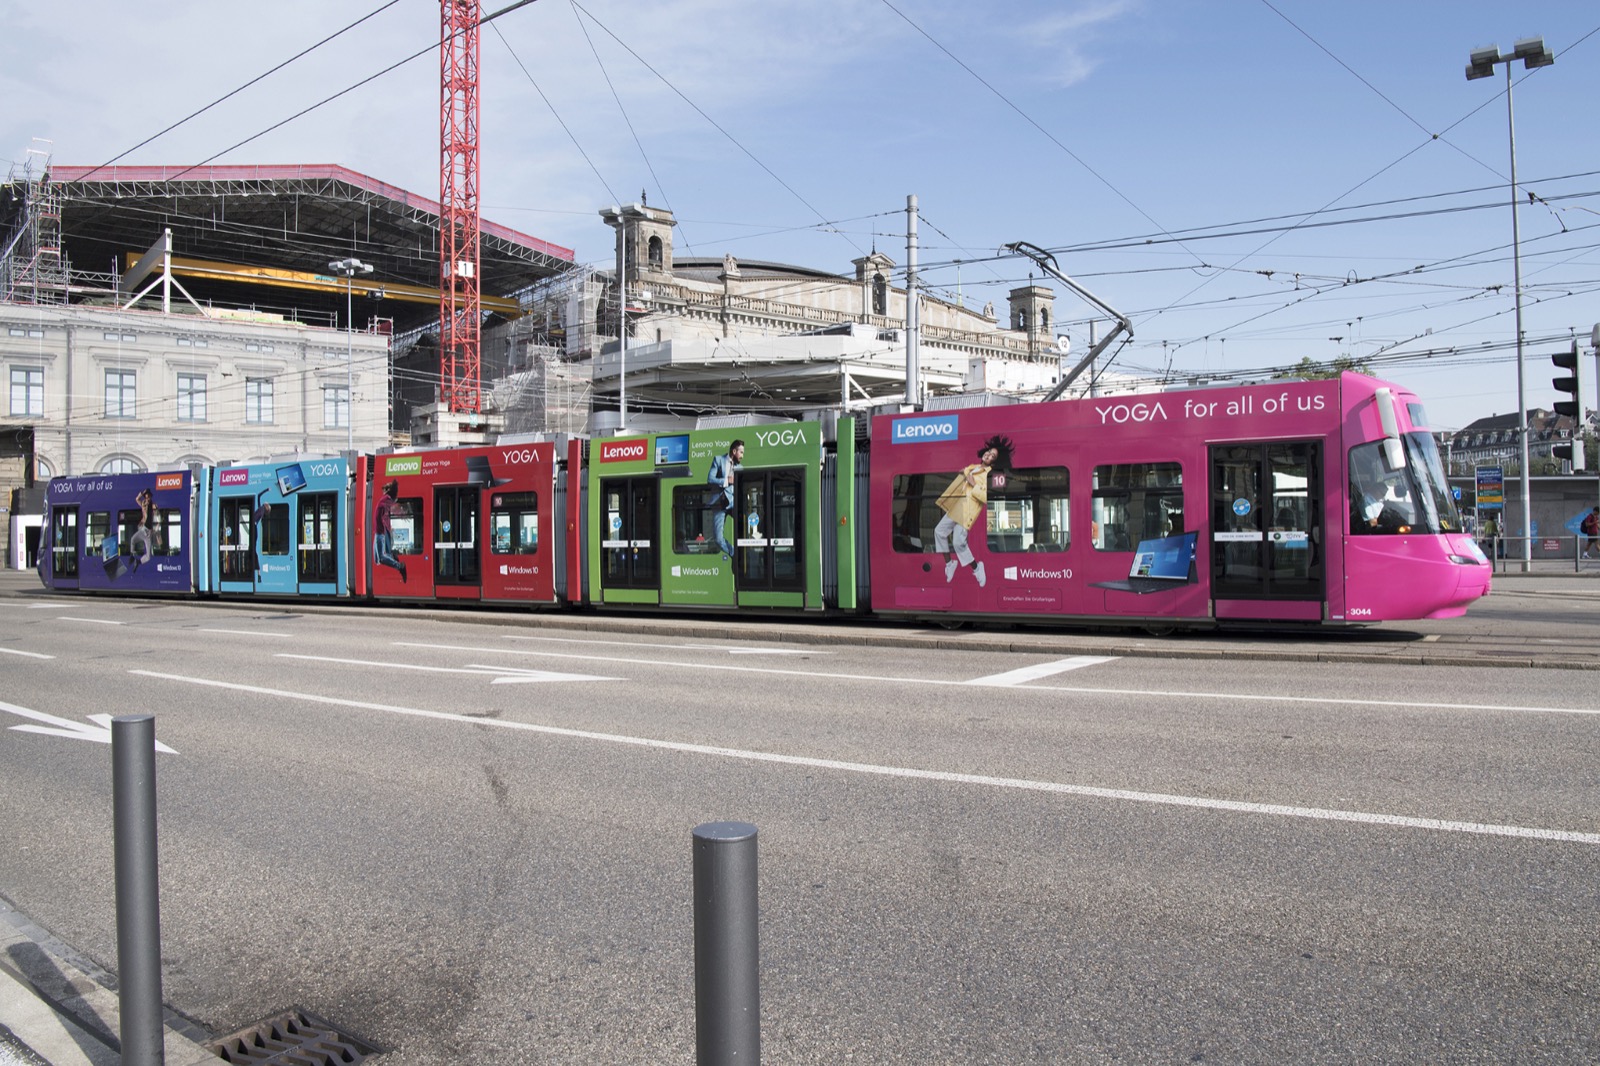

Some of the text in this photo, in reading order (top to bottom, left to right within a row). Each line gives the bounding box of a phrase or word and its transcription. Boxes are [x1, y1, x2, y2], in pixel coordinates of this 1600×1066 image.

[1095, 392, 1326, 425] YOGA for all of us
[896, 423, 953, 438] Lenovo
[755, 428, 807, 448] YOGA
[691, 440, 731, 449] Lenovo Yoga
[502, 449, 540, 464] YOGA
[603, 445, 645, 459] Lenovo
[310, 463, 339, 477] YOGA
[388, 462, 419, 472] Lenovo
[157, 477, 181, 487] Lenovo
[221, 473, 247, 483] Lenovo
[993, 475, 1005, 486] 10
[53, 480, 113, 493] YOGA for all of us
[508, 566, 539, 575] Windows 10
[682, 567, 719, 576] Windows 10
[1020, 568, 1073, 579] Windows 10
[1350, 608, 1372, 616] 3044
